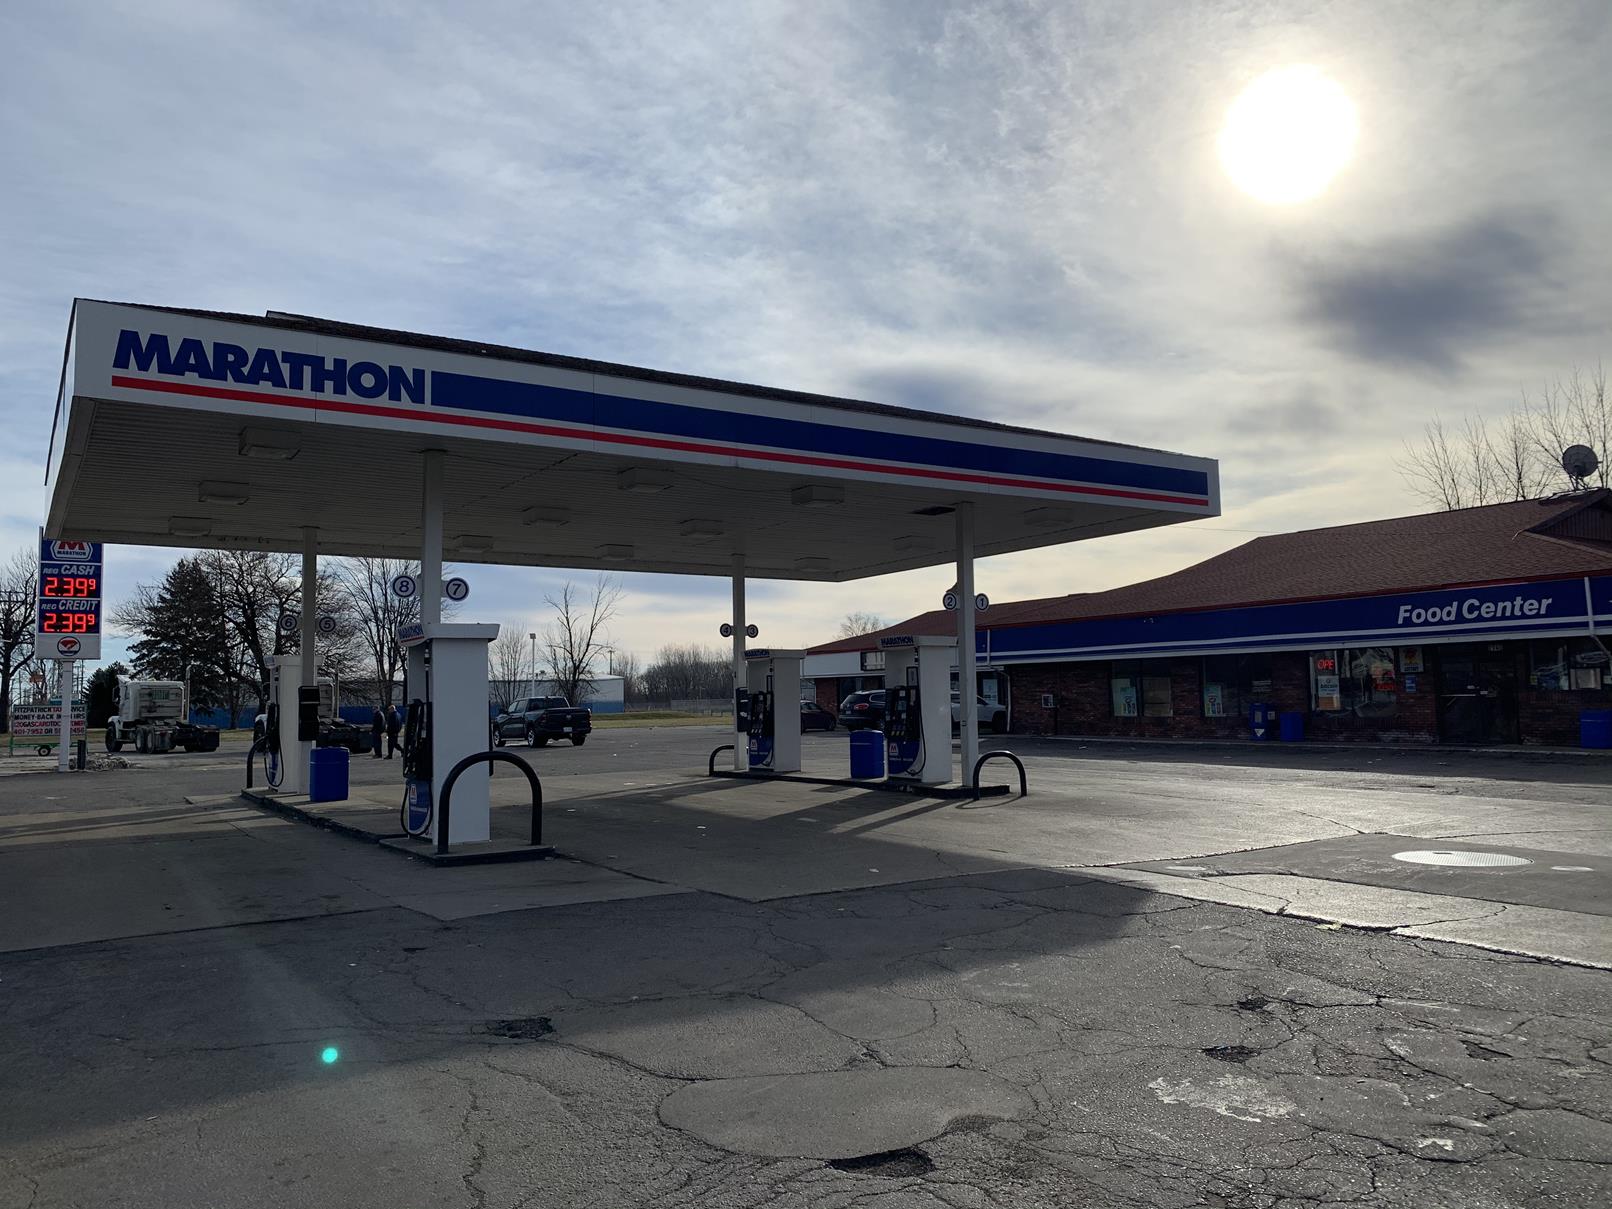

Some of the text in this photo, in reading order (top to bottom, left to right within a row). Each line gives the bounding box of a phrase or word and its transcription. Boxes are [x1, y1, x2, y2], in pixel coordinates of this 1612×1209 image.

[113, 329, 425, 405] MARATHON
[43, 564, 95, 576] REG CASH
[399, 581, 409, 593] 8
[453, 583, 462, 596] 7
[59, 600, 98, 611] CREDIT
[947, 596, 953, 607] 2
[980, 598, 984, 608] 1
[1397, 596, 1553, 625] Food Center
[284, 618, 293, 628] 6
[323, 620, 331, 629] 5
[723, 626, 729, 634] 4
[750, 627, 756, 635] 3
[880, 635, 914, 646] MARATHON
